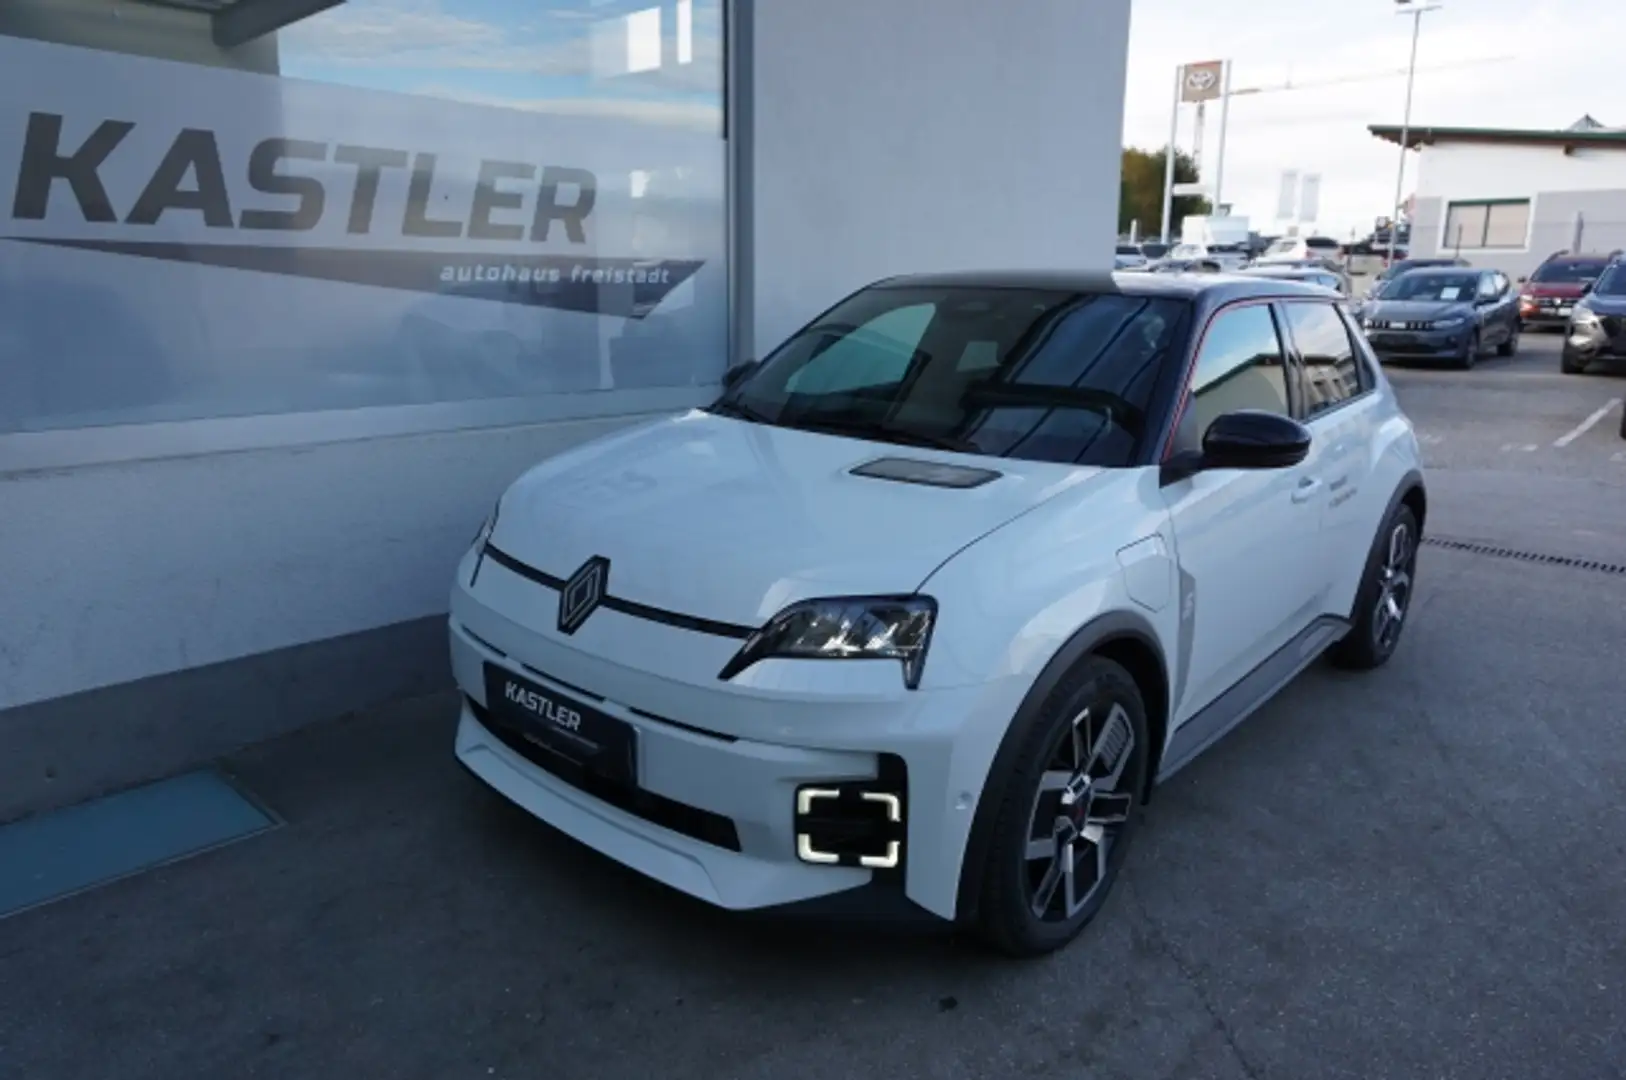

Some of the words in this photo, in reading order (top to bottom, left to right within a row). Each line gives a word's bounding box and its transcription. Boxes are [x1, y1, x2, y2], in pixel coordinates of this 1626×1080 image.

[12, 112, 597, 244] KASTLER
[440, 263, 560, 282] autohaus
[571, 264, 669, 285] freistadt
[505, 682, 582, 731] KASTLER
